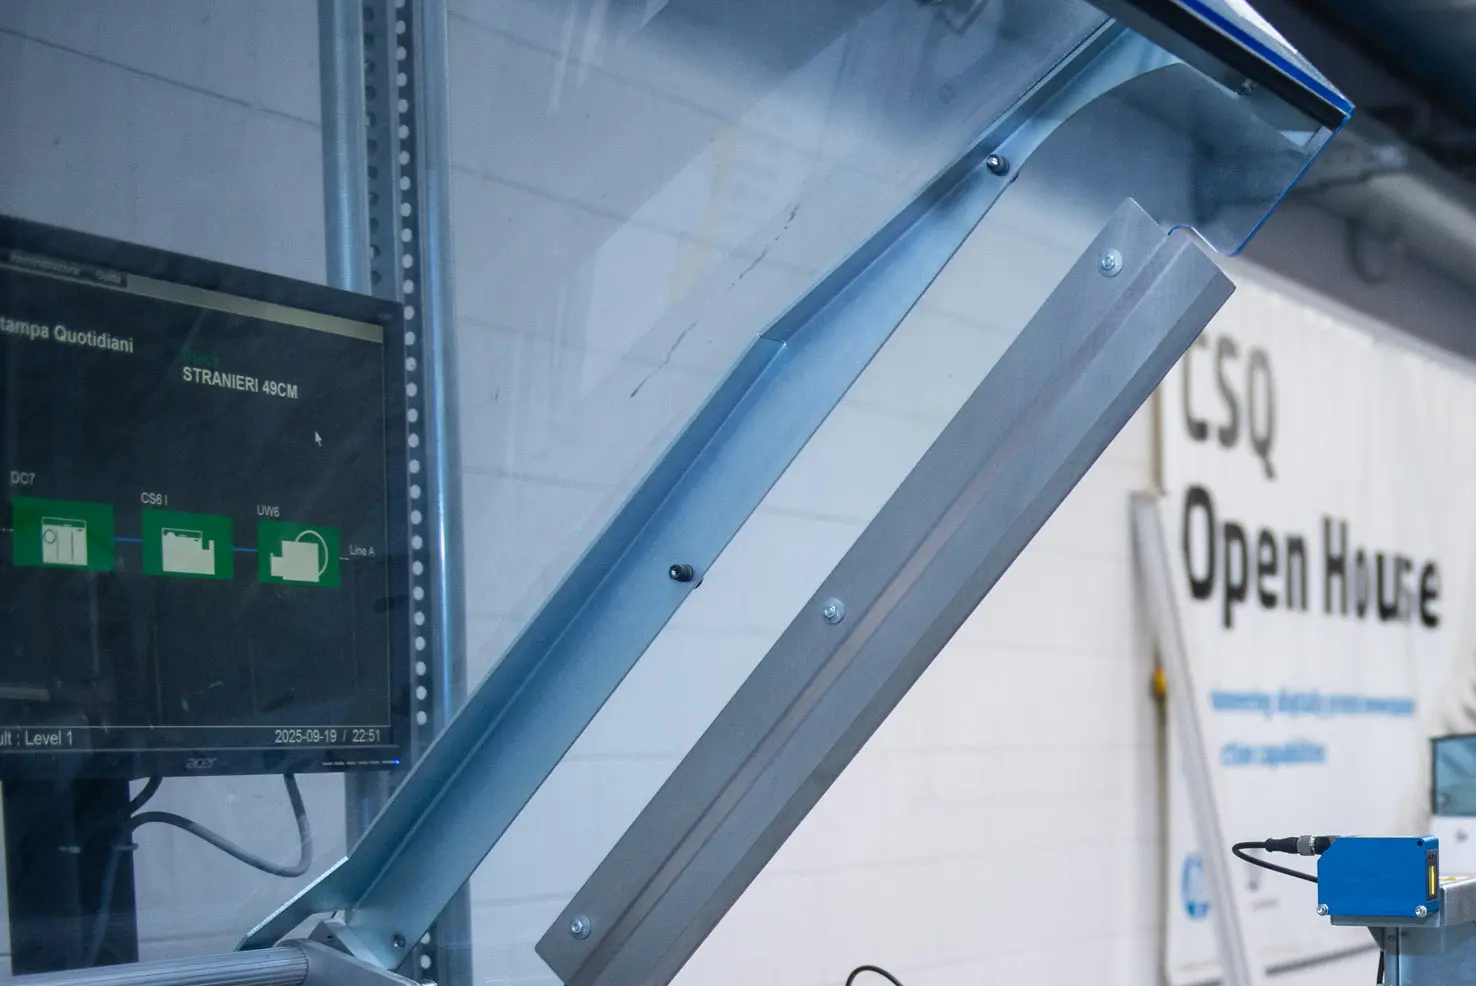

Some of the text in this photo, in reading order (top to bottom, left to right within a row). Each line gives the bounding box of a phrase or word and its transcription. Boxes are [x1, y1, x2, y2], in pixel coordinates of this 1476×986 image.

[54, 323, 135, 353] Quotidiani
[182, 365, 299, 400] STRANIERI 49CM
[10, 470, 36, 485] DC7
[140, 491, 163, 506] CS6
[256, 504, 281, 518] UW6
[1183, 484, 1442, 630] Open House
[25, 730, 62, 746] Level
[66, 730, 73, 746] 1
[274, 728, 338, 744] 2025-09-19
[351, 728, 381, 743] 22:51
[185, 756, 217, 769] acer
